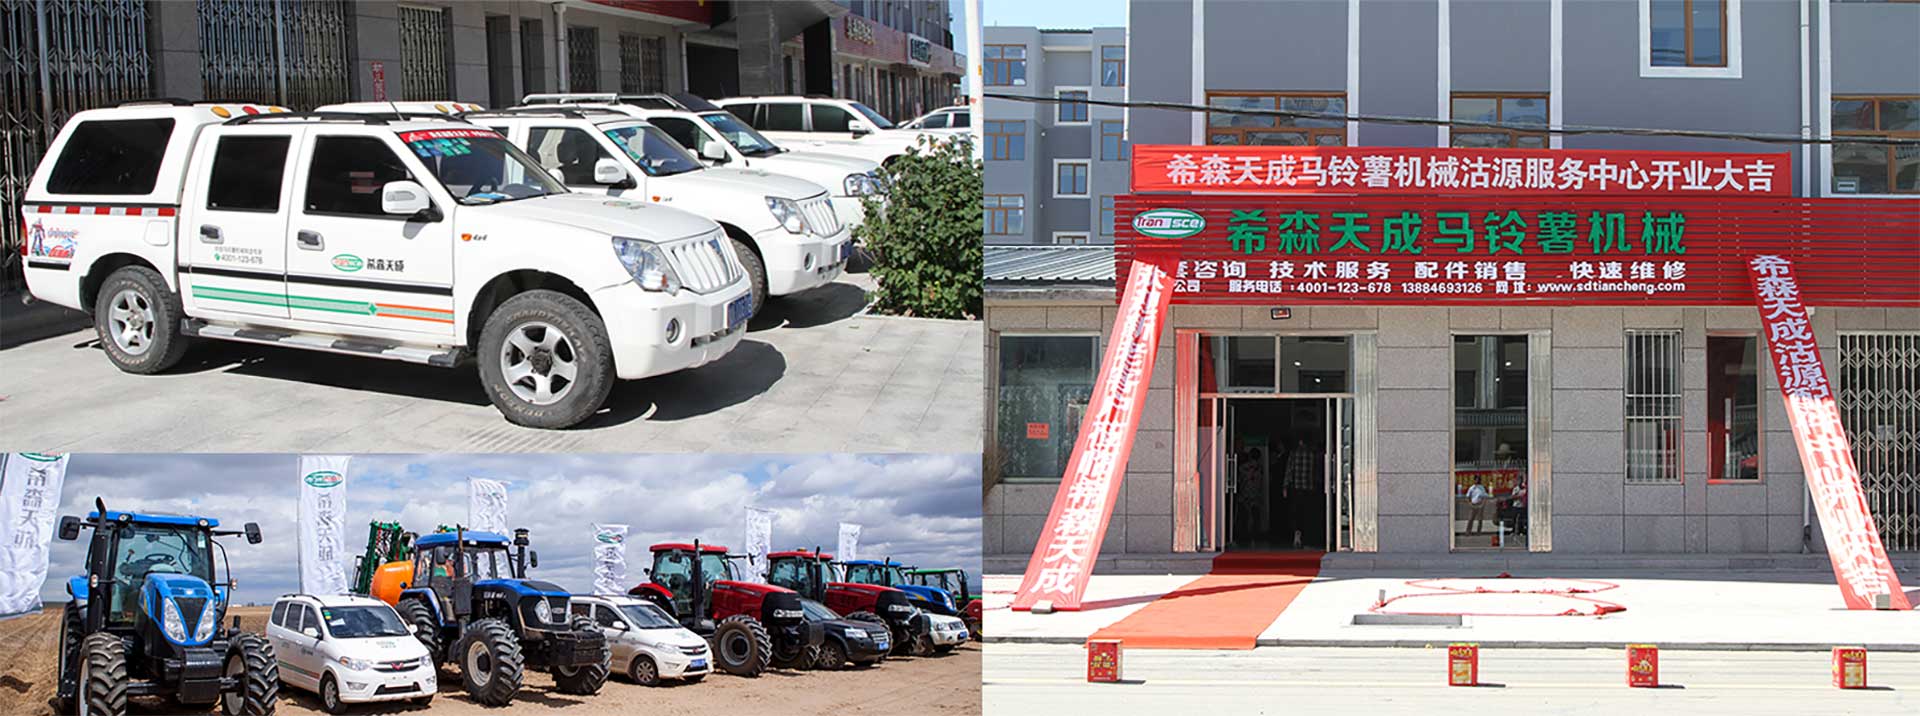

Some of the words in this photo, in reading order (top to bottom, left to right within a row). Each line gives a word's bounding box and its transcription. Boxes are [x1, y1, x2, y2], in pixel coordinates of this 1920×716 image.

[1166, 153, 1776, 192] 希森天成马铃薯机械沽源服务中心开业大吉
[1227, 209, 1686, 255] 希森天成马铃薯机械
[1269, 260, 1391, 280] 技术服务
[1414, 261, 1527, 280] 配件销售
[1569, 261, 1687, 280] 快速维修
[1401, 282, 1483, 294] 13884693126
[1536, 280, 1686, 295] www.sdtiancheng.com
